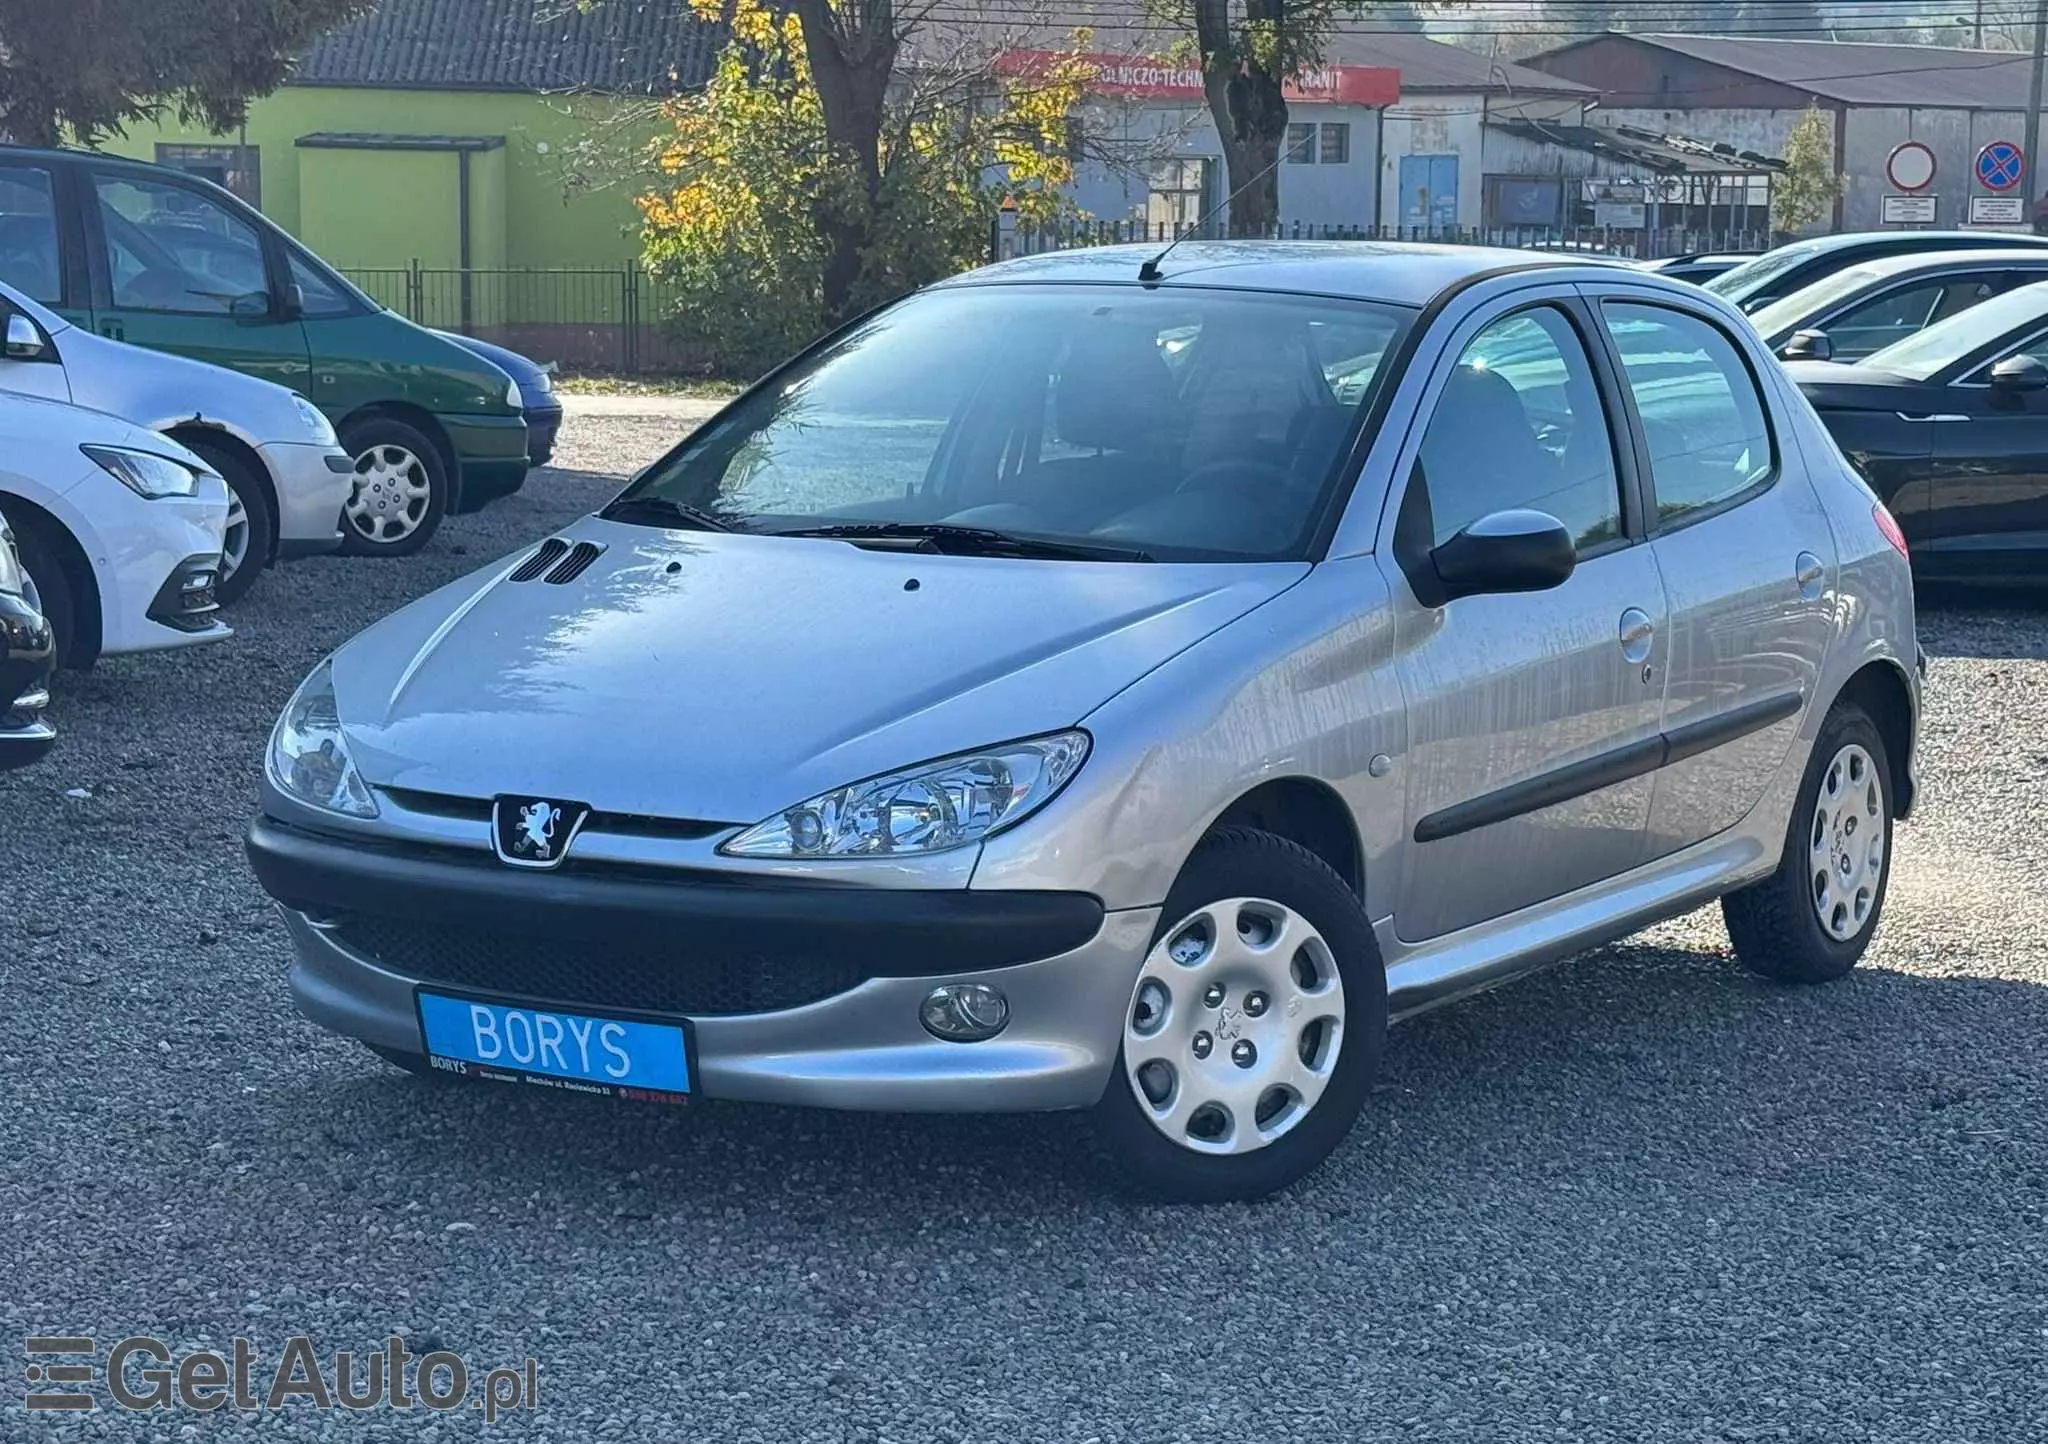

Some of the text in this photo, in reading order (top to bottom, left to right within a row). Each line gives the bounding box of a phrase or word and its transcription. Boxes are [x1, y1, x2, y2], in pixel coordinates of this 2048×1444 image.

[1101, 65, 1204, 88] OLNICZO-TECHN
[470, 1004, 631, 1079] BORYS
[430, 1055, 467, 1074] BORYS
